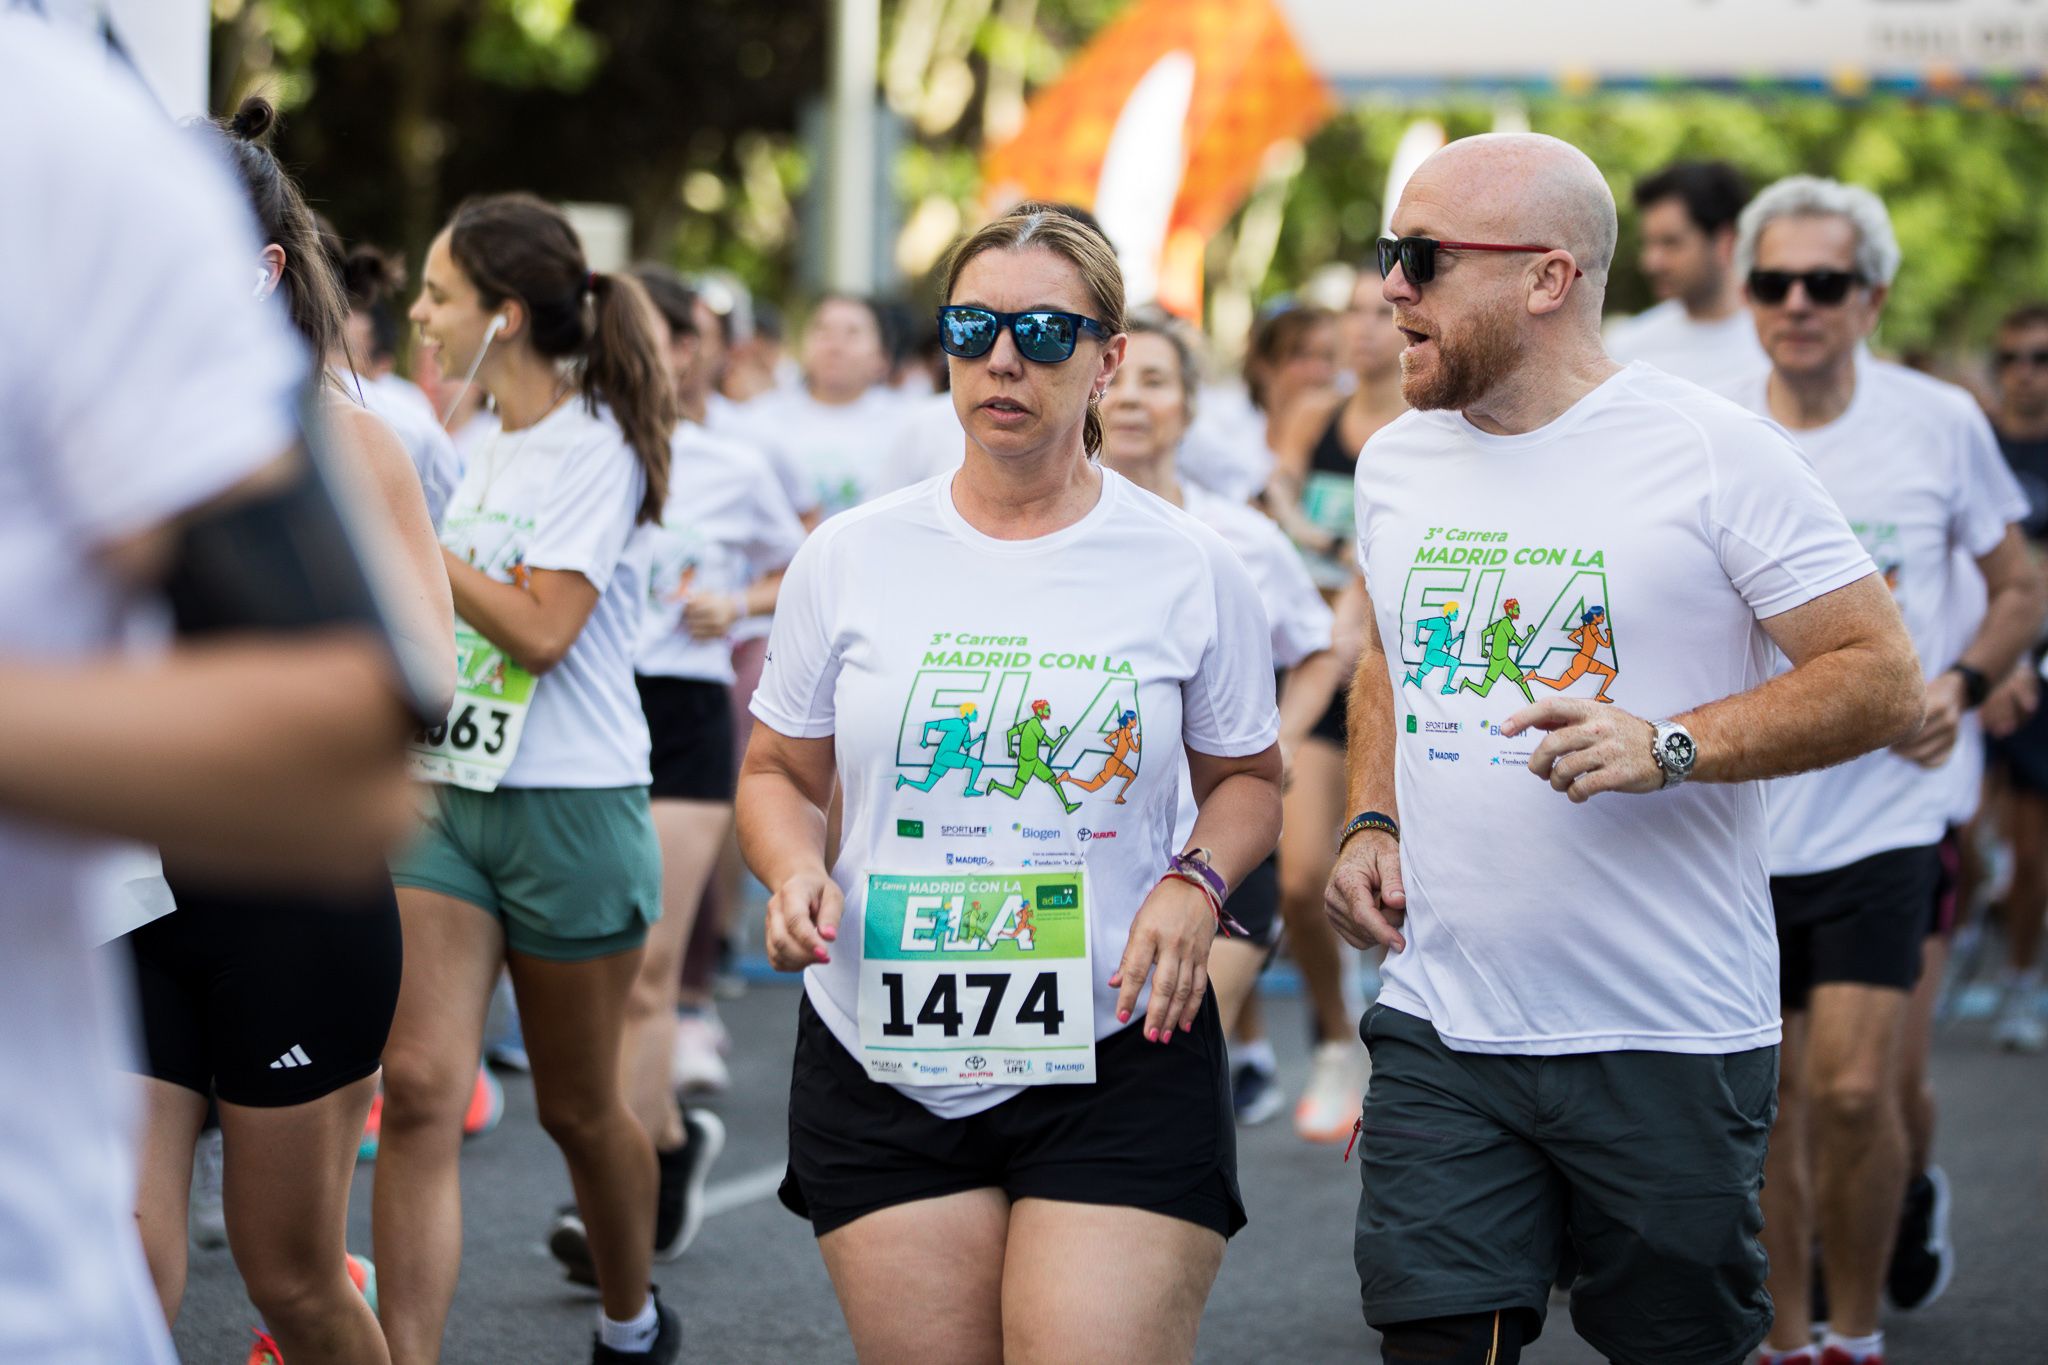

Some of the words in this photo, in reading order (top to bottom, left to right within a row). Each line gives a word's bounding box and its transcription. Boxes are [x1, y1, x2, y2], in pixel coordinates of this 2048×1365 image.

[1445, 528, 1508, 543] Carrera
[1414, 547, 1508, 566] MADRID
[1513, 548, 1567, 566] CON
[1571, 550, 1605, 568] LA
[1400, 567, 1619, 674] ELA
[955, 633, 1028, 647] Carrera
[922, 651, 1032, 668] MADRID
[1039, 652, 1096, 670] CON
[1103, 657, 1134, 675] LA
[896, 670, 1142, 776] ELA
[1435, 751, 1459, 762] MADRID
[1022, 828, 1060, 840] Biogen
[955, 856, 987, 865] MADRID
[909, 881, 966, 894] MADRID
[969, 881, 1000, 893] CON
[1003, 880, 1022, 892] LA
[1042, 895, 1073, 905] adELA
[900, 895, 1035, 951] ELA
[882, 972, 1065, 1037] 1474
[920, 1065, 948, 1074] Biogen
[1007, 1066, 1023, 1074] LIFE
[1055, 1064, 1085, 1072] MADRID
